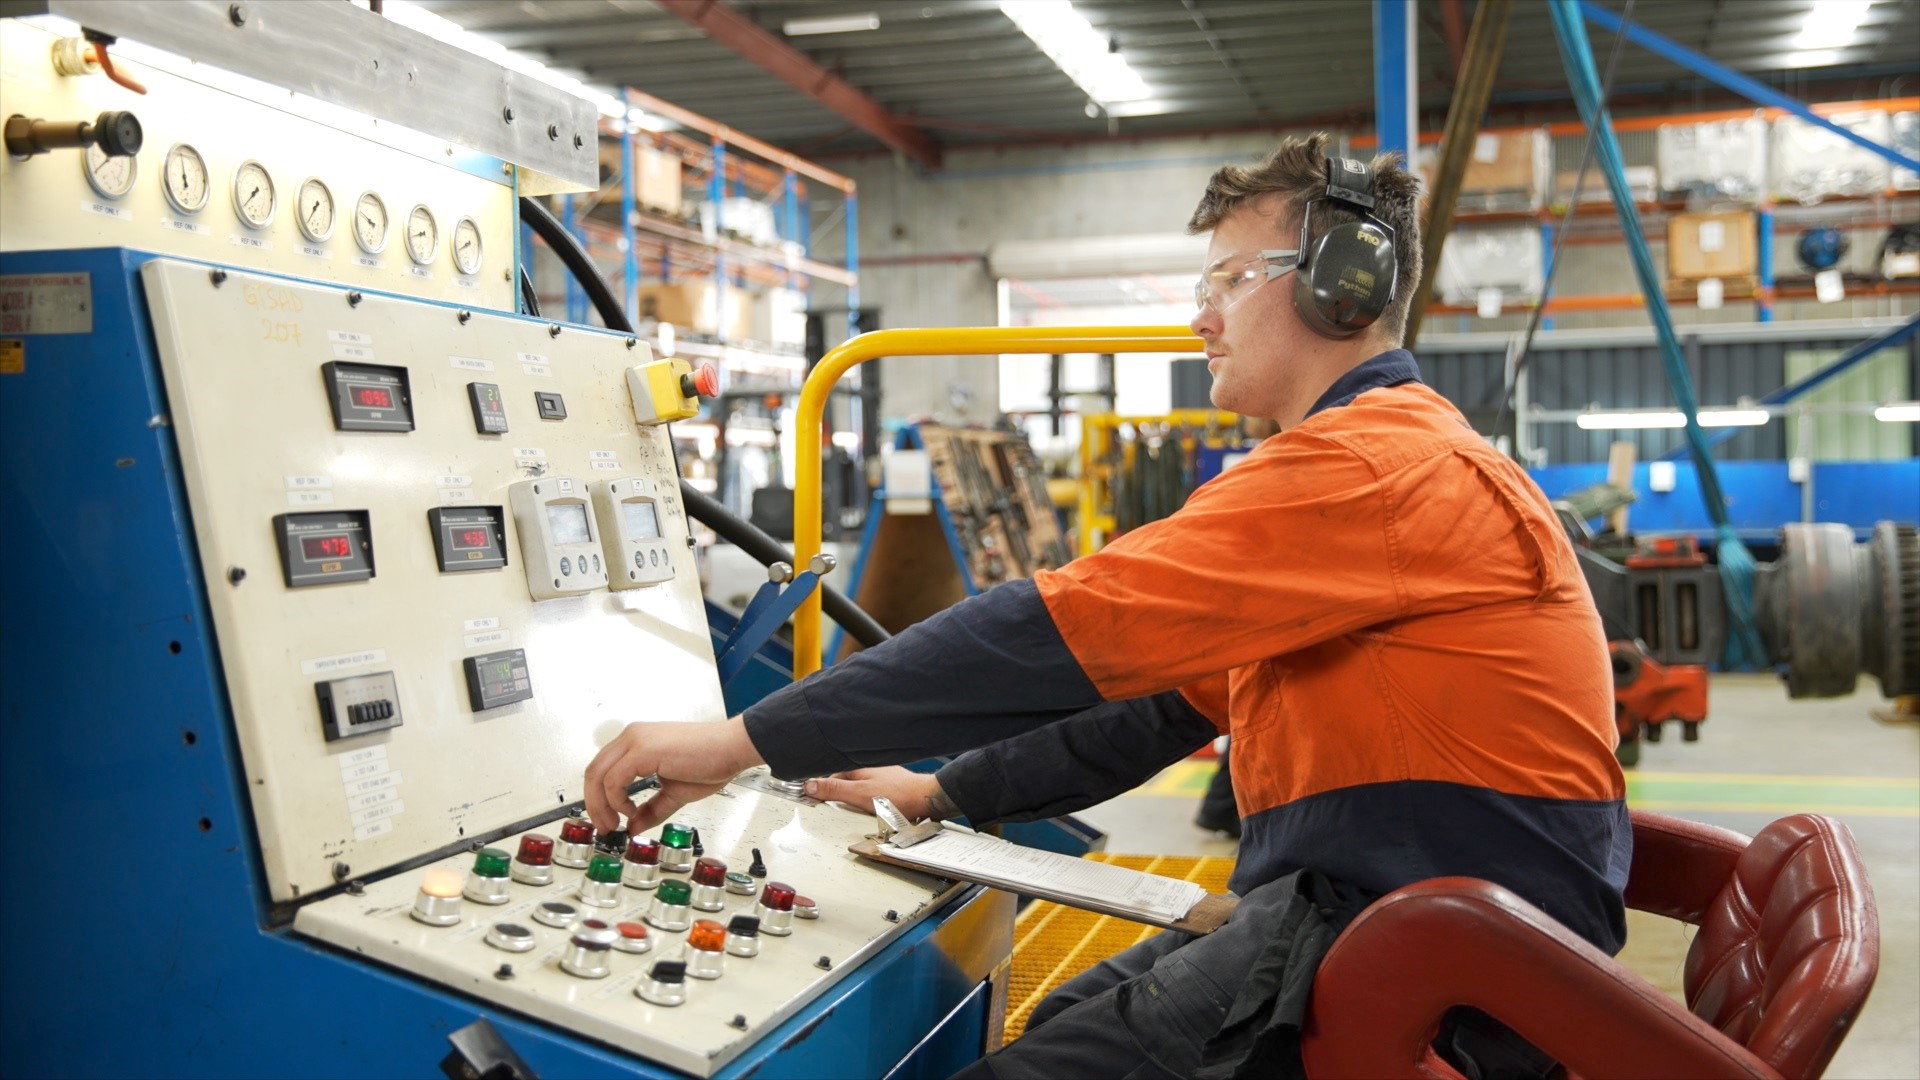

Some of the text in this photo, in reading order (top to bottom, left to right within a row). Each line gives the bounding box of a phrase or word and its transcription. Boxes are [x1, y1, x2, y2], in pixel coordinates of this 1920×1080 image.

[92, 204, 120, 216] REF ONLY
[173, 220, 198, 231] REF ONLY
[240, 237, 263, 247] REF ONLY
[1356, 231, 1380, 247] PRO
[312, 248, 323, 256] ONLY
[368, 259, 378, 267] ONLY
[1338, 279, 1371, 298] Python
[338, 333, 361, 342] REF ONLY
